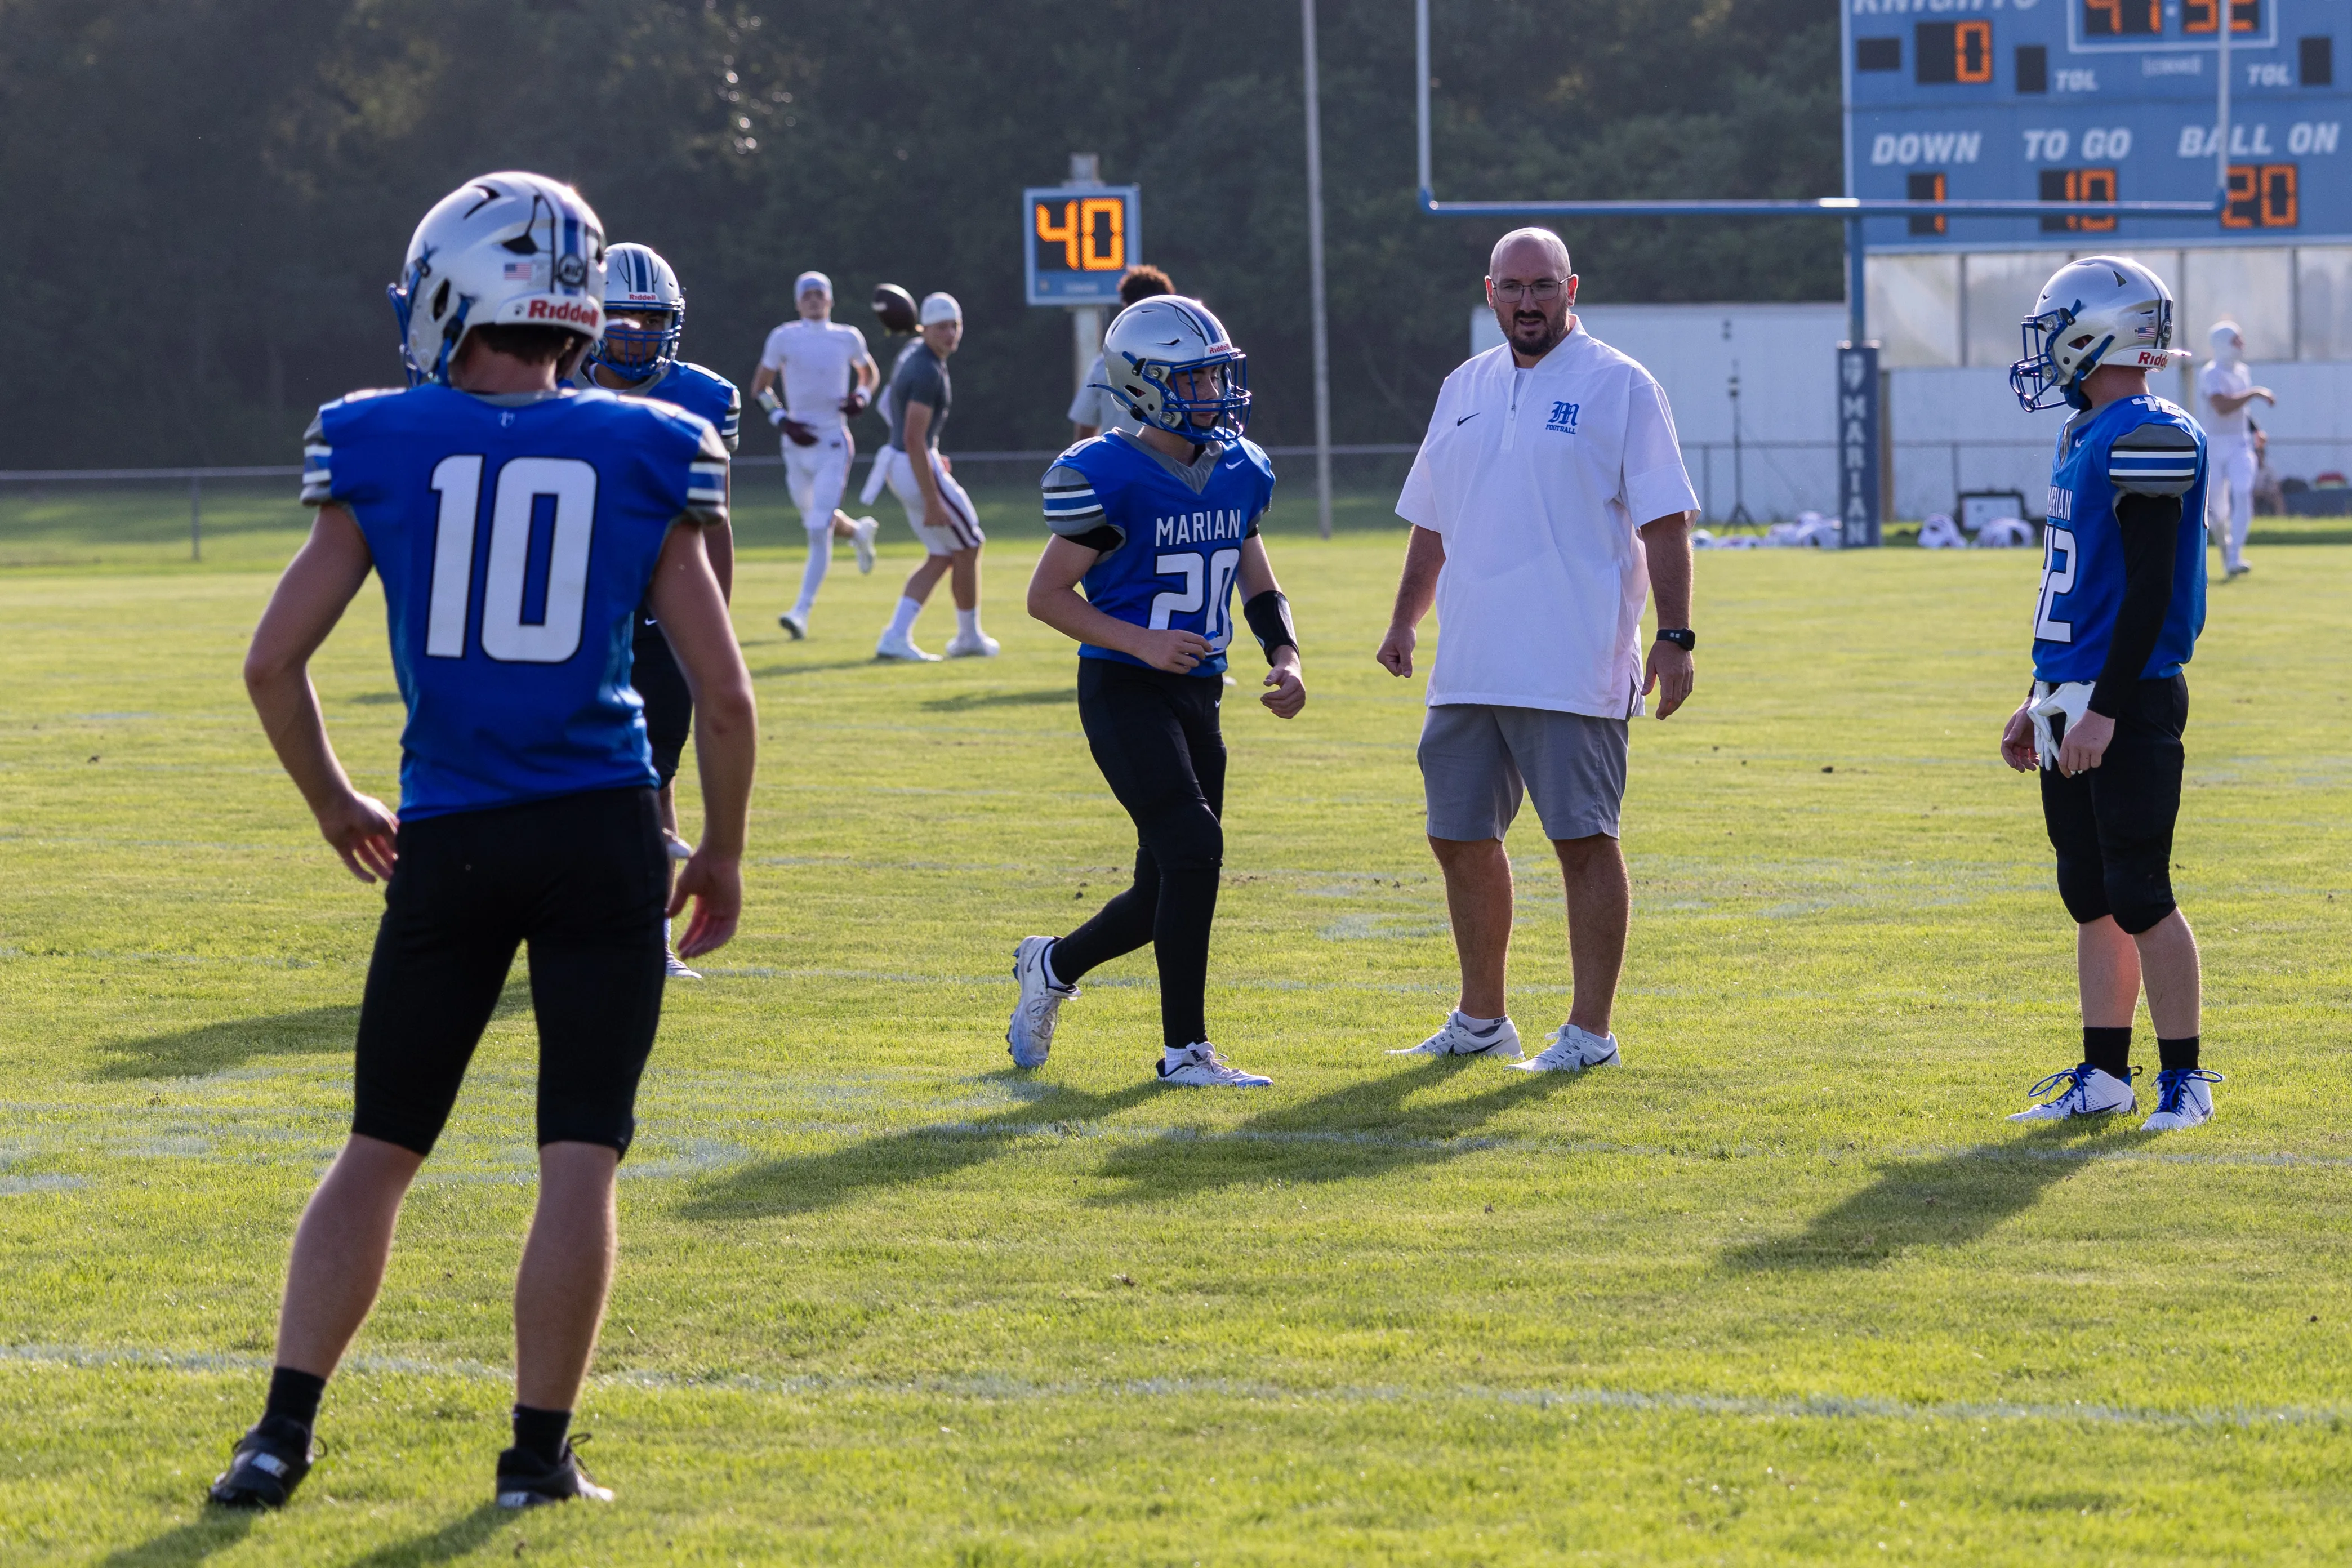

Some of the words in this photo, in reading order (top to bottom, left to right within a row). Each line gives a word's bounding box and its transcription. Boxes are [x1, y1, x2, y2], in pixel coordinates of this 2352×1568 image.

[1955, 21, 1992, 82] 0
[1871, 133, 1981, 165] DOWN
[2023, 129, 2070, 161] TO
[2081, 127, 2133, 161] GO
[2287, 121, 2340, 155] ON
[2065, 168, 2116, 233] 10
[2221, 164, 2297, 228] 20
[1036, 198, 1124, 271] 40
[2137, 351, 2168, 367] Ridd
[1545, 424, 1576, 435] FOOTBALL
[1842, 395, 1867, 545] MARIAN
[425, 454, 598, 663] 10
[1156, 509, 1240, 547] MARIAN
[1148, 548, 1240, 656] 20
